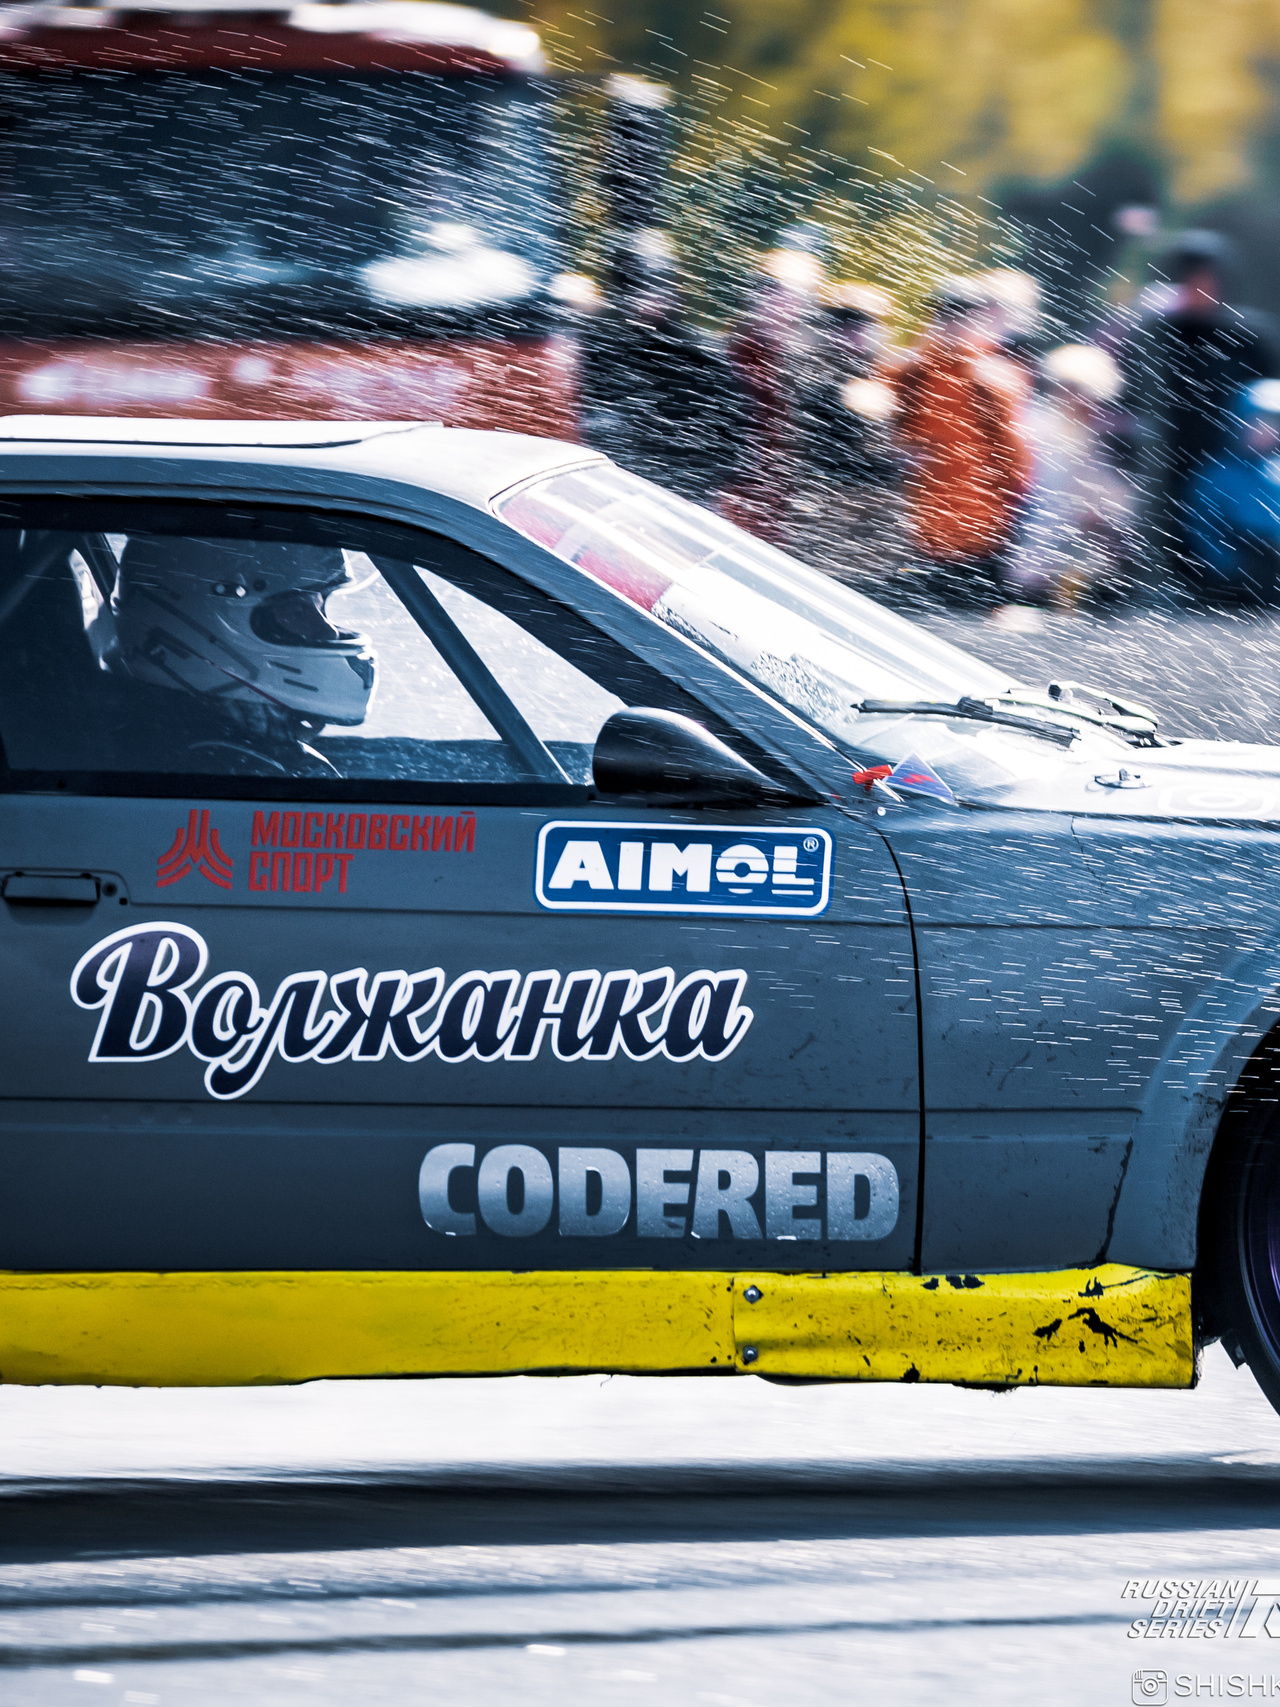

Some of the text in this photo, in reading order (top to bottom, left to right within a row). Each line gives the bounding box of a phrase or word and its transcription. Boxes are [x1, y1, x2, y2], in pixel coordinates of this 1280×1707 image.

[250, 810, 476, 853] МОСКОВСКИЙ
[248, 852, 349, 893] СПОРТ
[70, 921, 754, 1100] Волжанка
[418, 1143, 899, 1242] CODERED
